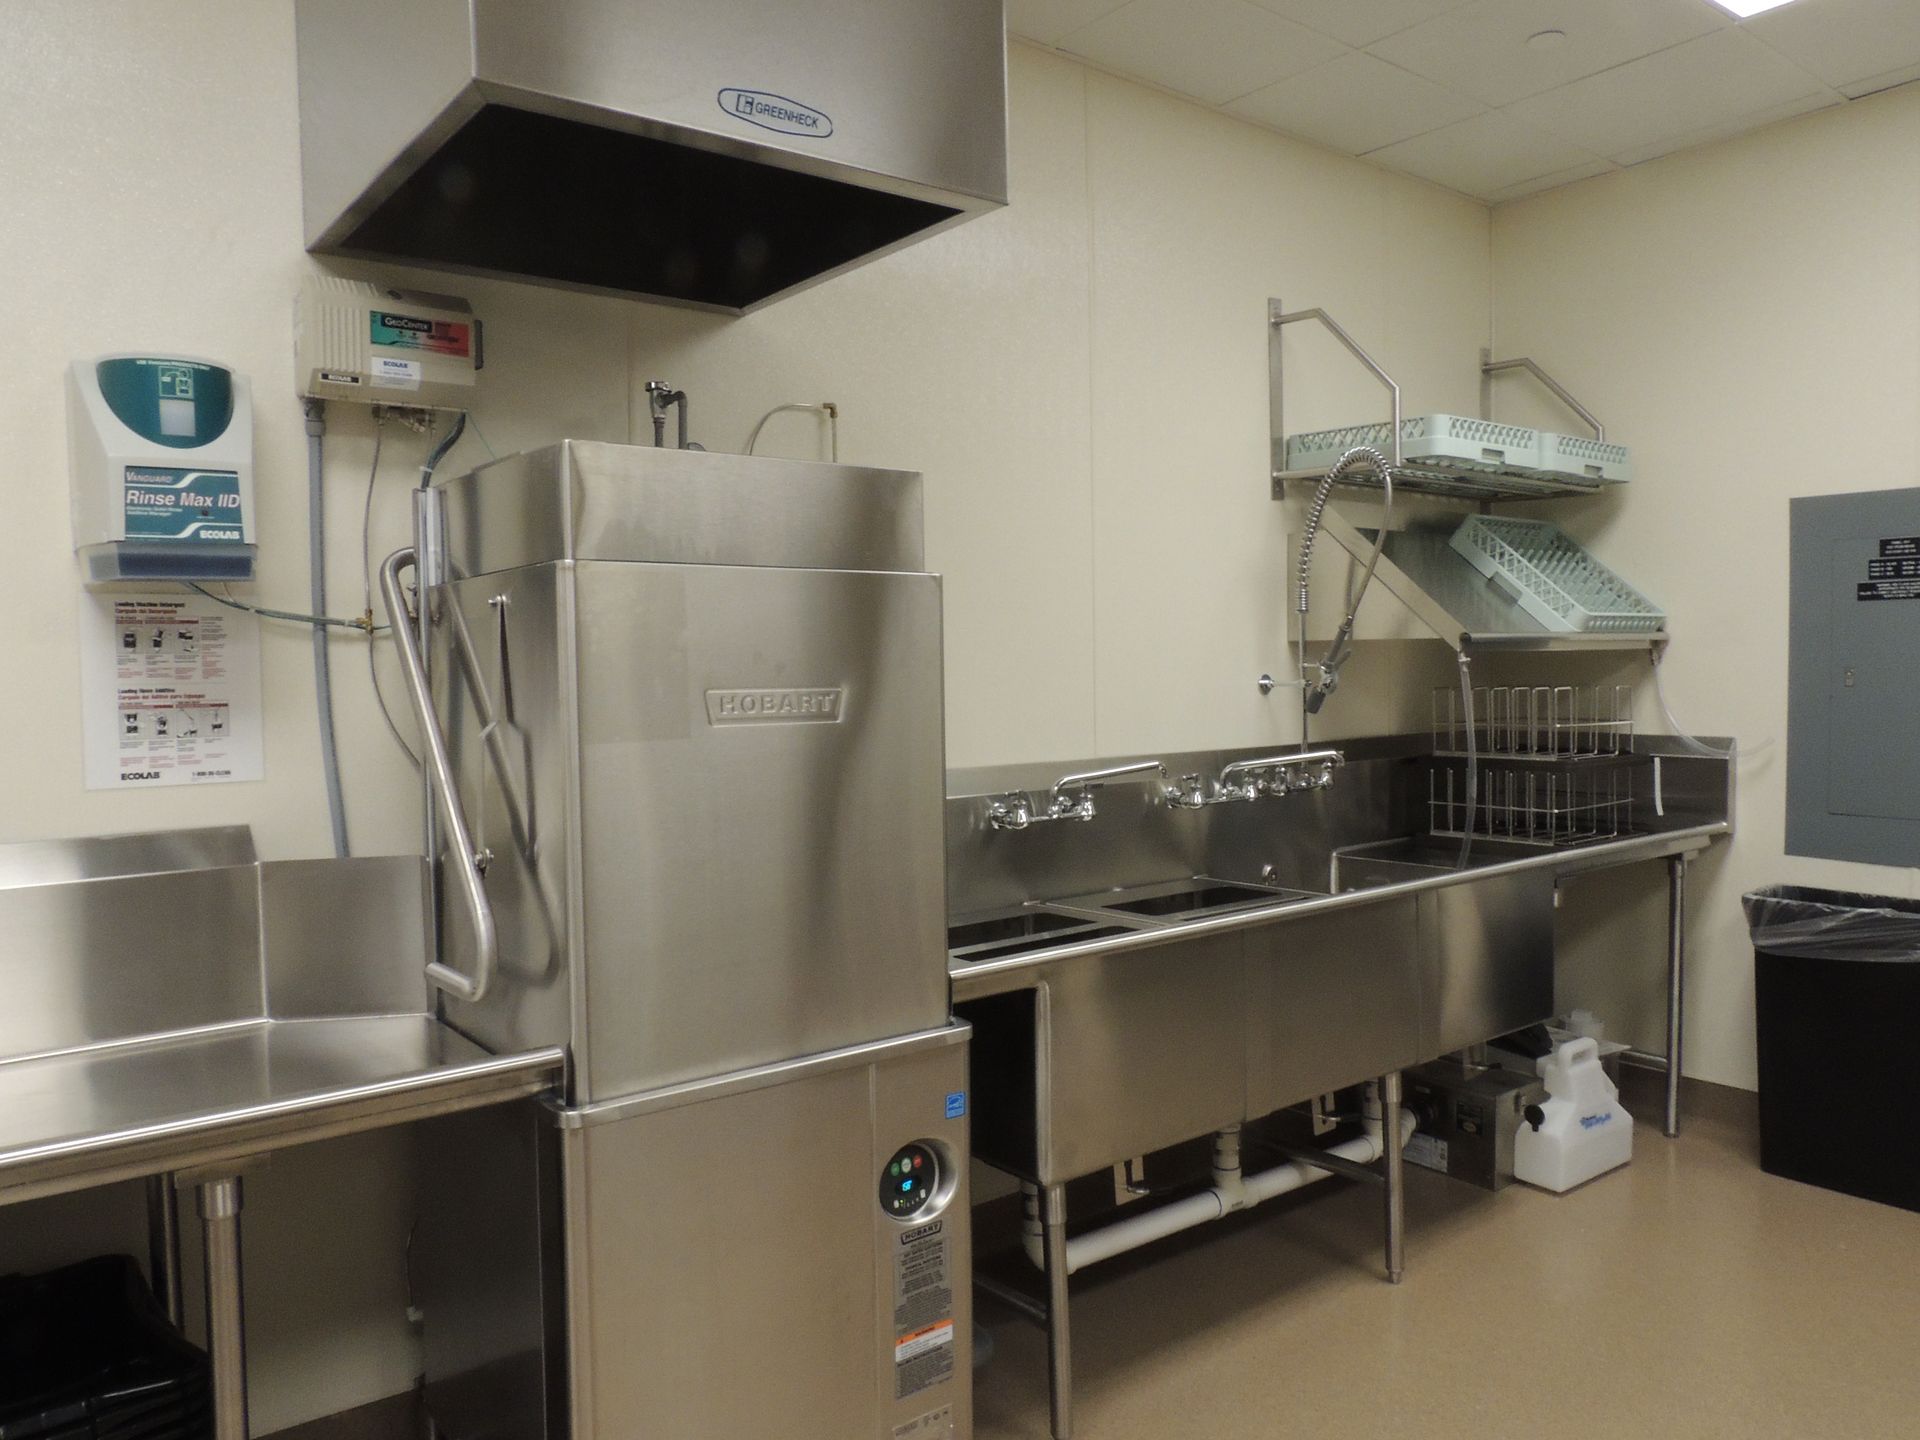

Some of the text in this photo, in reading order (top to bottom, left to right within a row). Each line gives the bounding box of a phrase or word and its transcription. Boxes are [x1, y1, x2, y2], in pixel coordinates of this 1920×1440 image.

[755, 101, 820, 129] GREENHECK
[126, 490, 240, 508] Rinse Max IID
[199, 530, 241, 539] ECOLAB
[719, 694, 834, 715] HOBART
[120, 771, 161, 781] ECOLAB
[904, 1223, 939, 1241] HOBART
